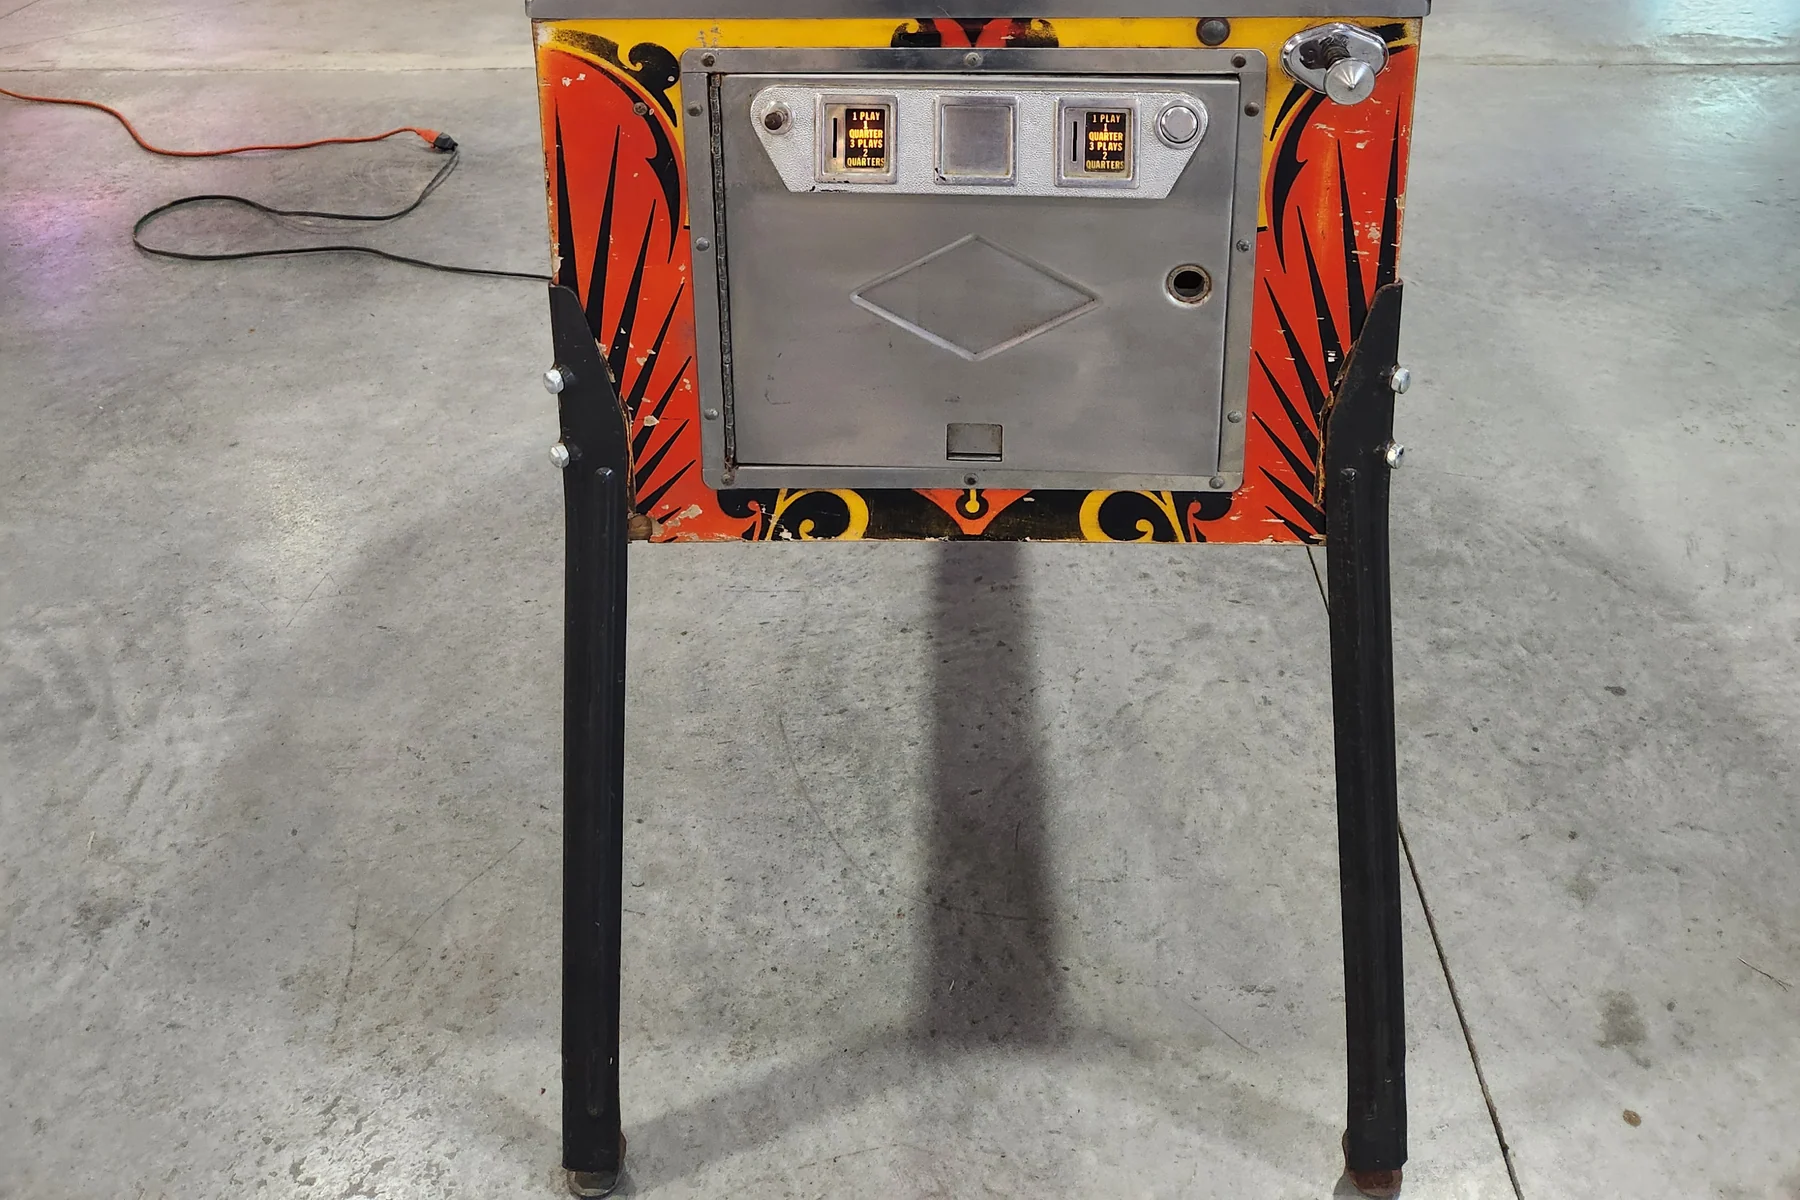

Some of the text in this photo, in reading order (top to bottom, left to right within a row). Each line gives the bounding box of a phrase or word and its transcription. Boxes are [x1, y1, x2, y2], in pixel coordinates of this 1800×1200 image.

[853, 112, 880, 120] 1 PLAY
[1093, 115, 1120, 123] 1 PLAY
[863, 121, 868, 129] 1
[1103, 123, 1108, 131] 1
[849, 129, 883, 138] QUARTER
[1088, 132, 1123, 141] QUARTER
[850, 140, 883, 148] 3 PLAYS
[1089, 142, 1123, 151] 3 PLAYS
[863, 149, 868, 157] 2
[1102, 152, 1108, 160] 2
[847, 158, 885, 166] QUARTERS
[1086, 161, 1124, 169] QUARTERS
